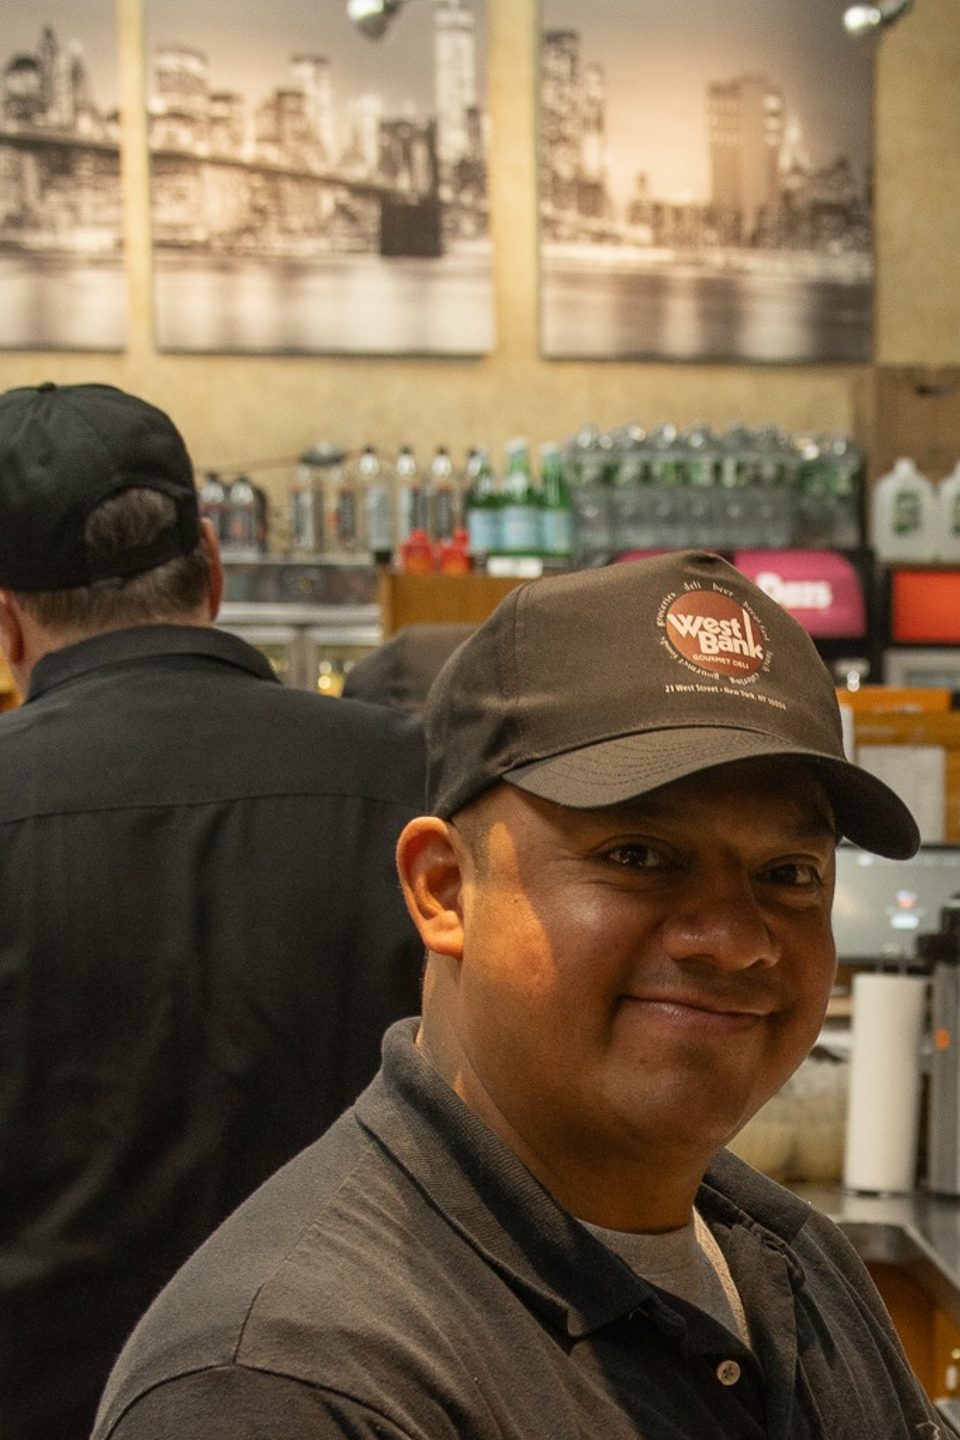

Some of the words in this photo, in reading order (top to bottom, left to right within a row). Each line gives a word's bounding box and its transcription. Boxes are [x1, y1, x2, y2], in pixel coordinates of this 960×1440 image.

[666, 612, 743, 640] West
[698, 608, 764, 660] Bank
[692, 653, 731, 665] GOURMET
[732, 659, 749, 670] DELI
[665, 684, 675, 693] 21
[674, 684, 696, 693] West
[695, 683, 719, 694] Street
[723, 687, 740, 696] New
